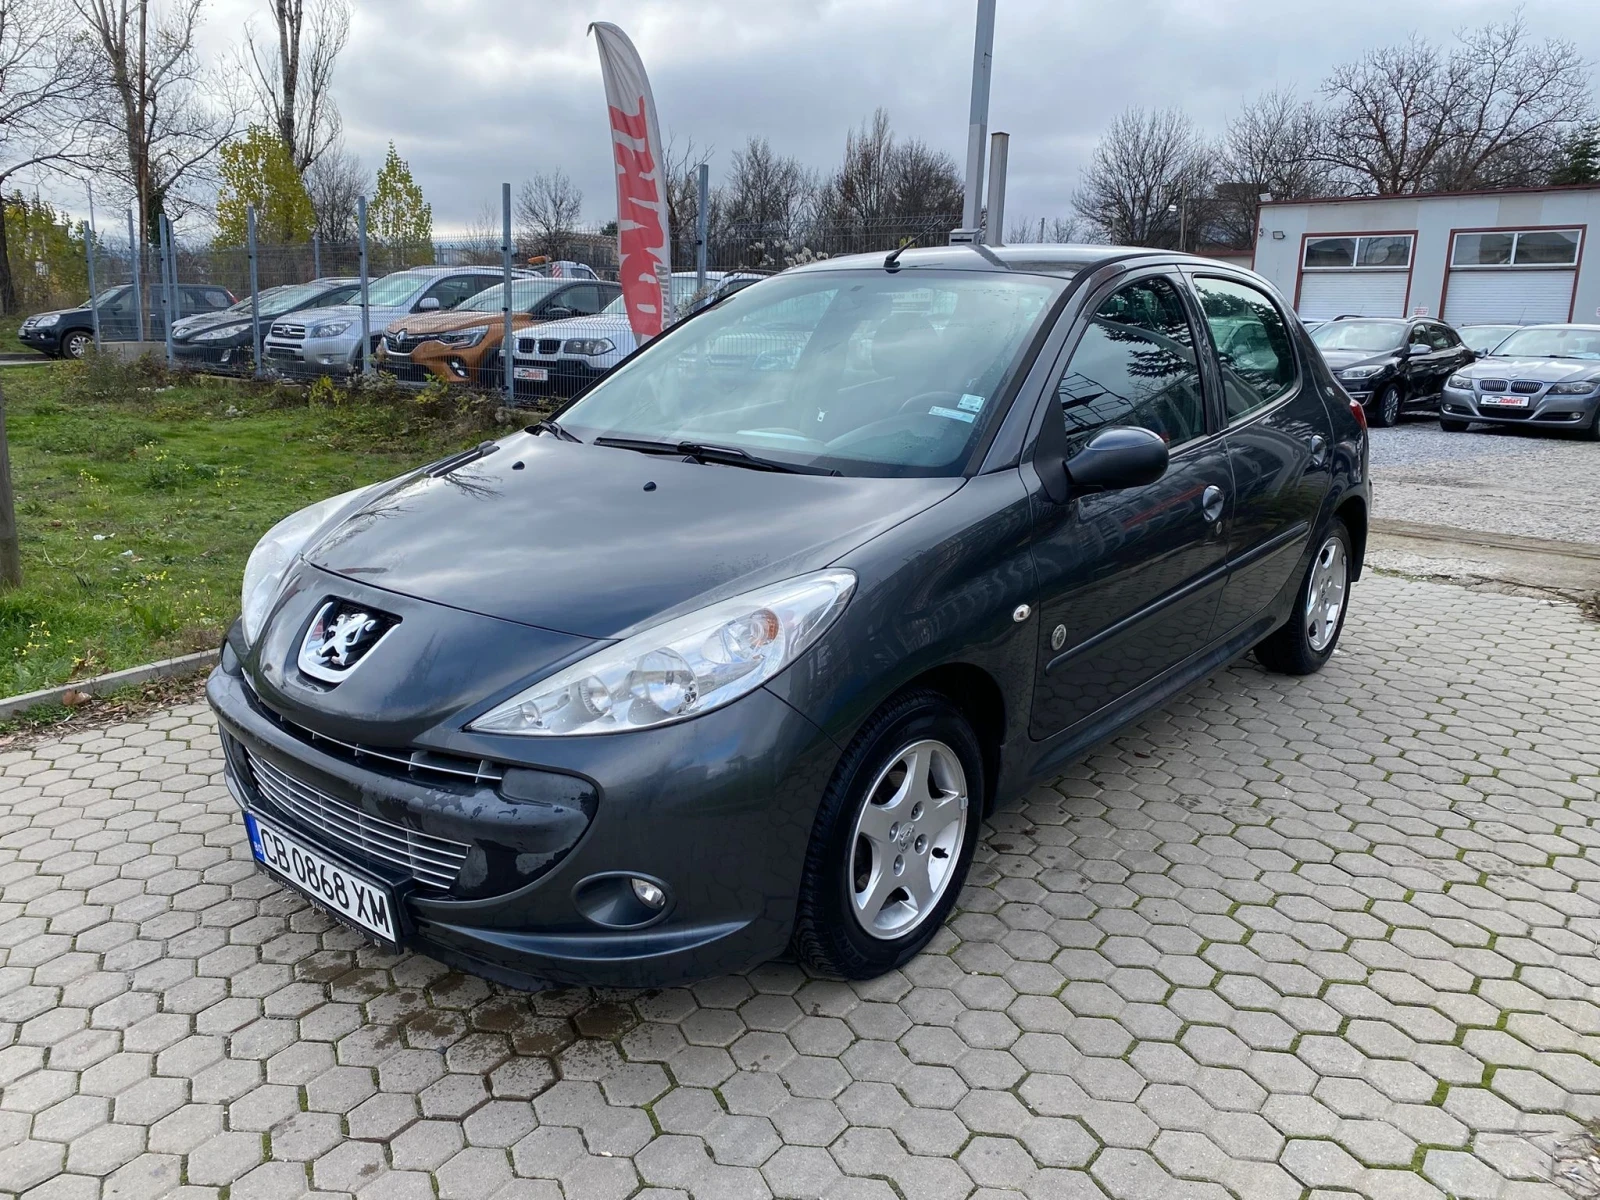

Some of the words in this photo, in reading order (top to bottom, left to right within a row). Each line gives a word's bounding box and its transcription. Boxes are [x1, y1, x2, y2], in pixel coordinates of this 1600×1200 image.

[260, 828, 291, 874] CB
[292, 847, 350, 910] 0868
[350, 879, 391, 934] XM
